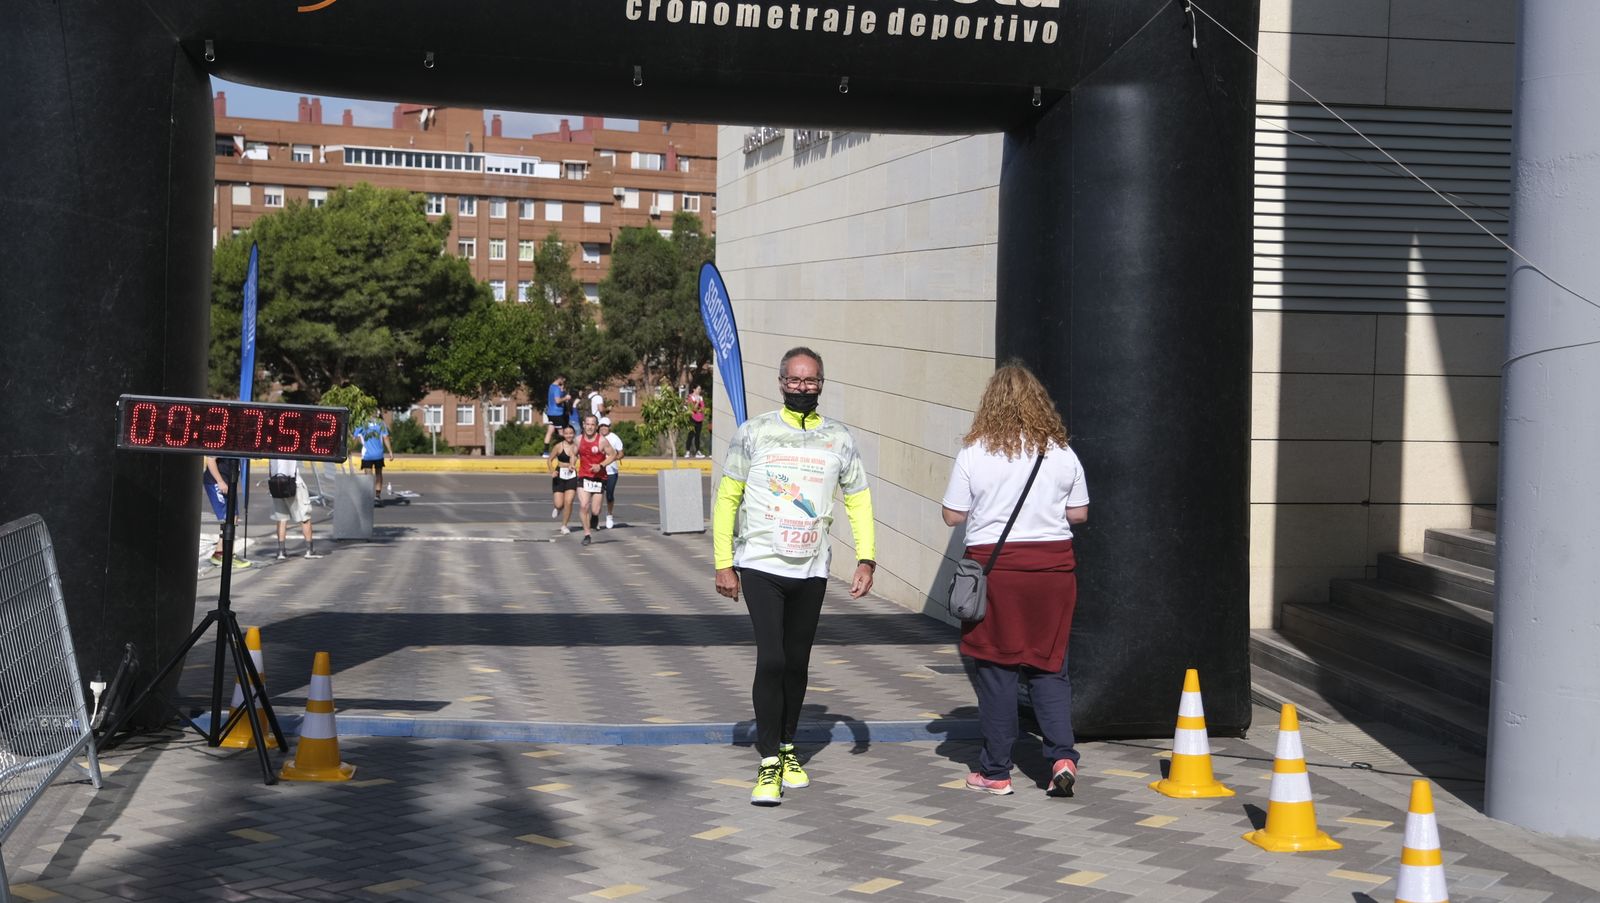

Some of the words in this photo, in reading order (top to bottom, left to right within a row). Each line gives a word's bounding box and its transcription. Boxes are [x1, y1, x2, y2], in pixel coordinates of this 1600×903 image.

[626, 0, 877, 36] cronometraje
[887, 7, 1059, 44] deportivo
[130, 402, 337, 454] 00:37:52
[781, 530, 818, 543] 1200
